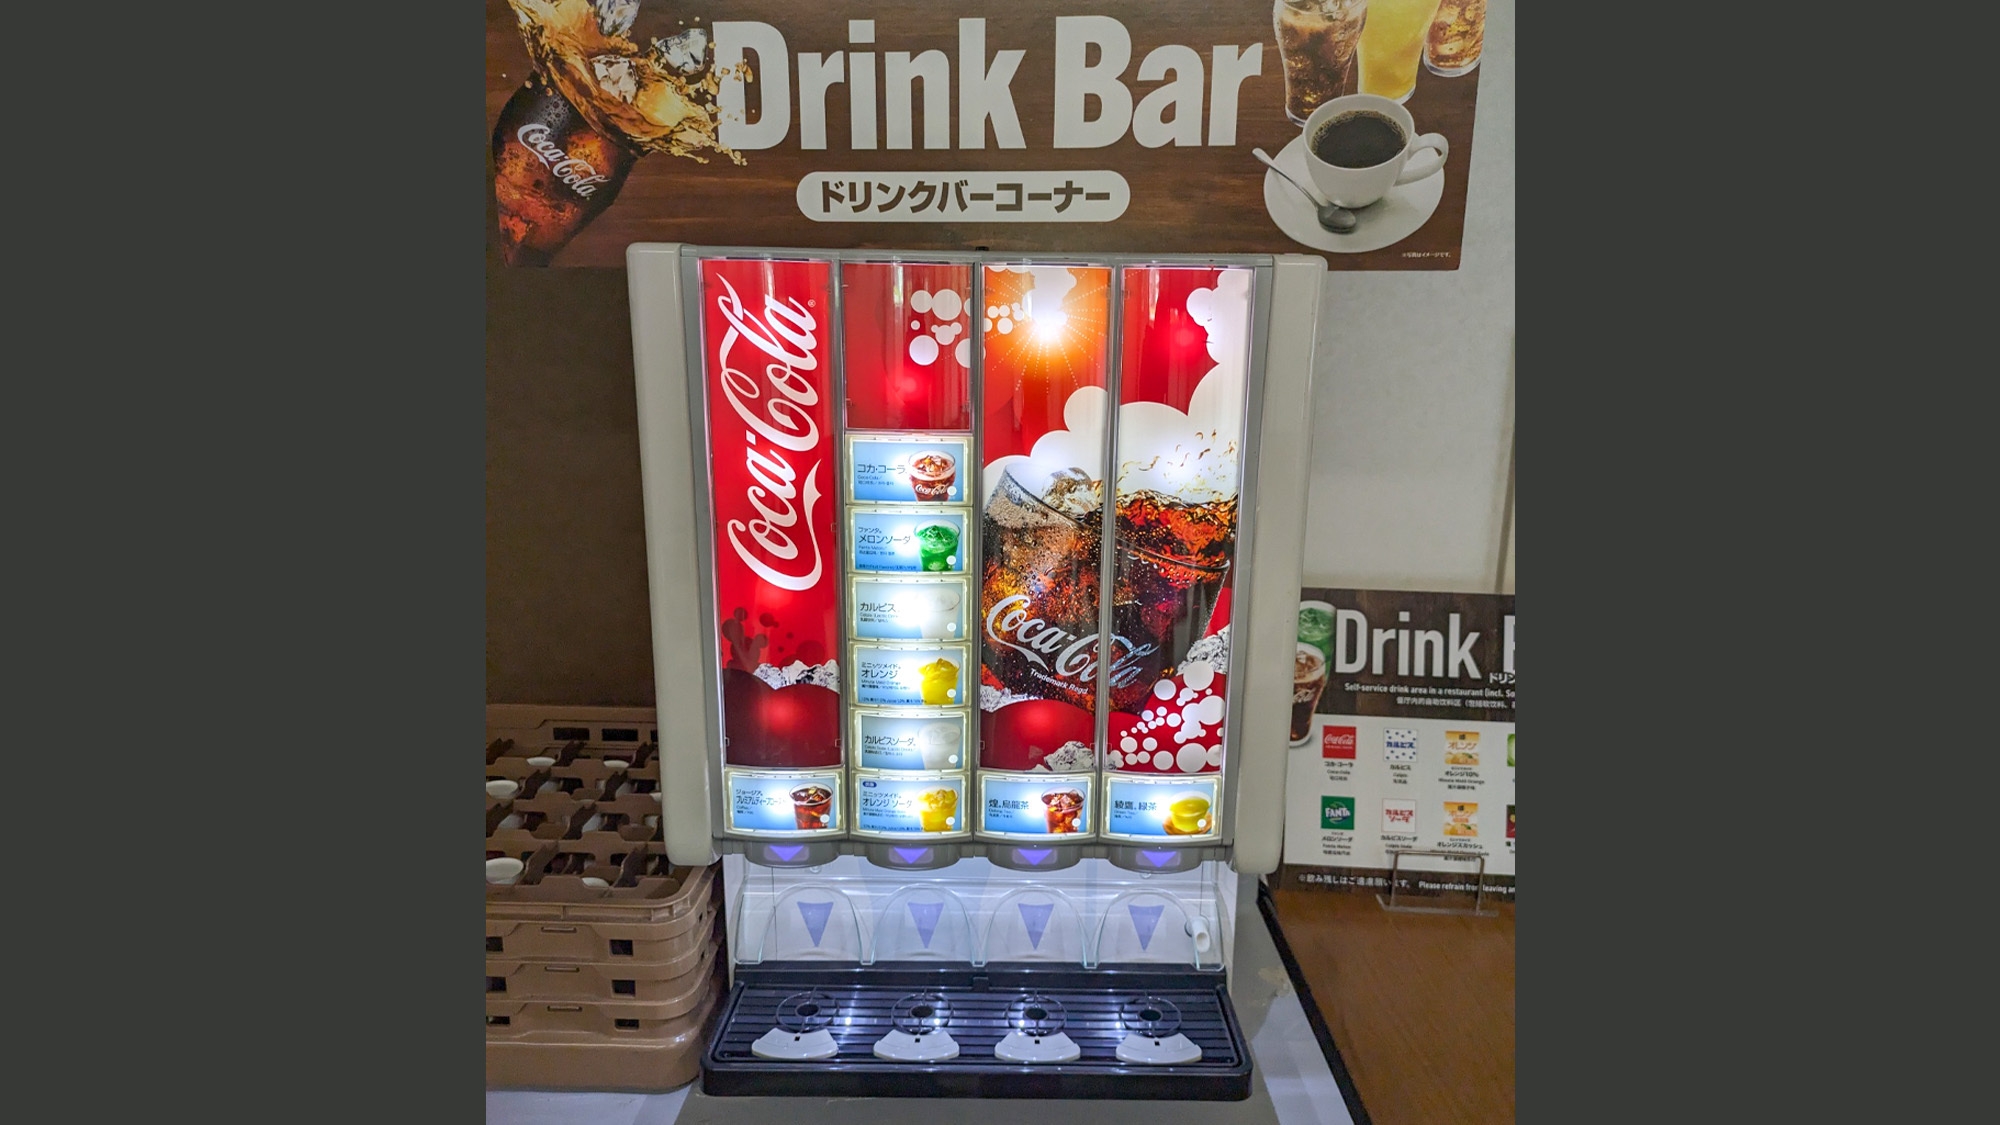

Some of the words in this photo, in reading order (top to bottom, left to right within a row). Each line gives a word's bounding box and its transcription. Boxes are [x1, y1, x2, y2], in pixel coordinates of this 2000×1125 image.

[713, 17, 1026, 150] Drink
[1053, 15, 1263, 149] Bar
[821, 180, 1111, 214] ドリンクバーコーナー
[716, 272, 823, 592] Coca-Cola
[858, 535, 911, 545] メロンソーダ
[860, 602, 896, 613] カルピス
[1335, 608, 1482, 679] Drink
[861, 669, 898, 679] オレンジ
[1029, 667, 1068, 690] Trademark
[1344, 682, 1388, 692] Self-service
[1389, 684, 1410, 694] drink
[1410, 686, 1427, 695] area
[1429, 685, 1436, 695] in
[1444, 687, 1483, 697] restaurant
[864, 735, 914, 747] カルピスソーダ
[1386, 741, 1415, 749] カルピス
[1448, 741, 1477, 750] オレンジ
[1325, 807, 1351, 818] FANTA
[1418, 880, 1441, 890] Please
[1441, 882, 1465, 891] refrain
[1482, 884, 1507, 894] leaving
